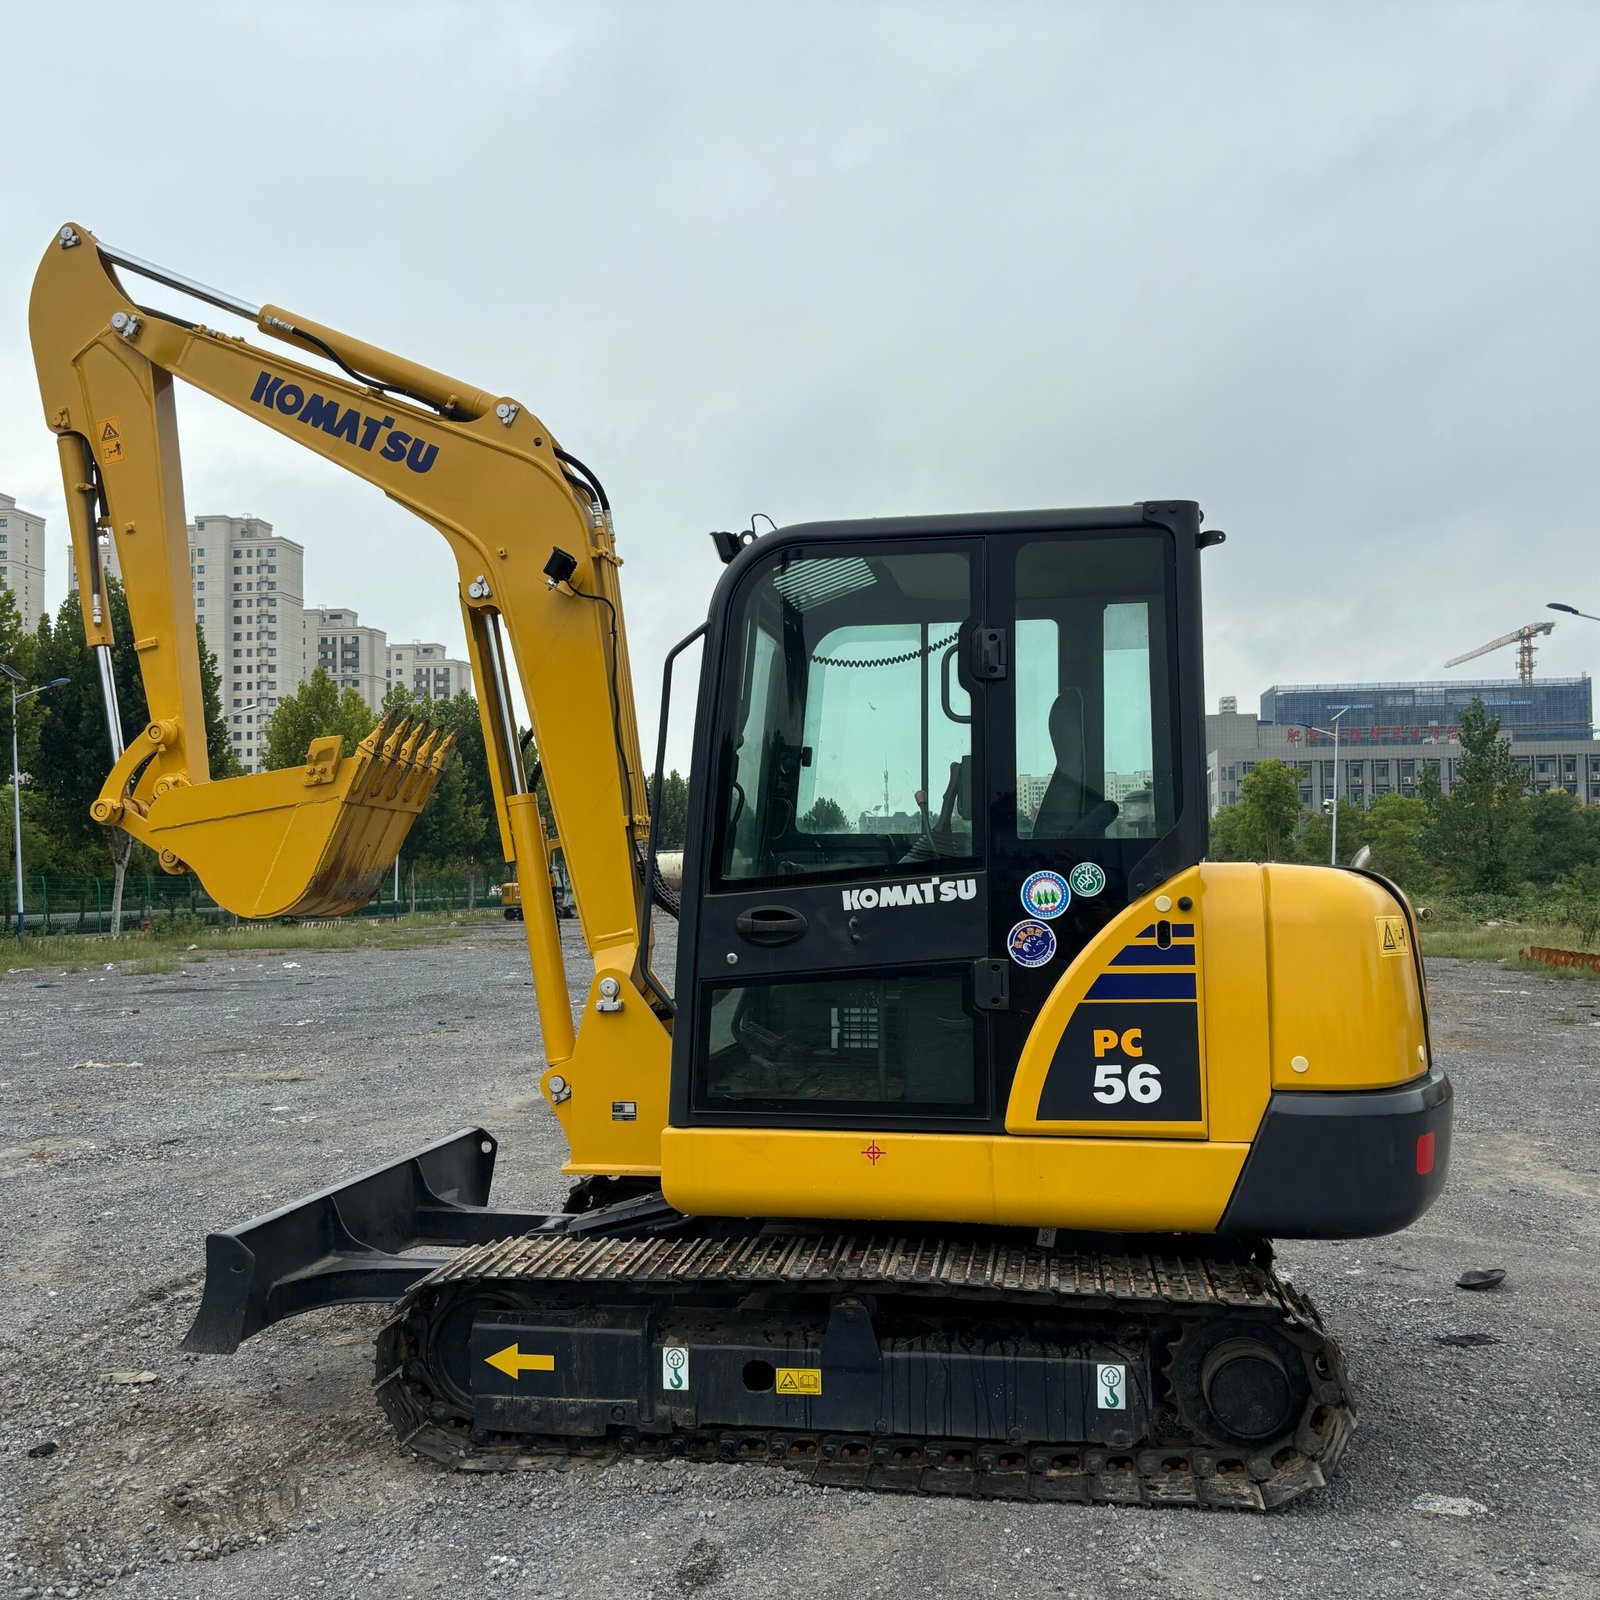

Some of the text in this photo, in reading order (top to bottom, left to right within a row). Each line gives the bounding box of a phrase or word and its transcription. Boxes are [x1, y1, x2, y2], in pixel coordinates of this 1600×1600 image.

[250, 370, 440, 474] KOMATSU
[842, 877, 977, 911] KOMATSU
[1093, 1028, 1143, 1057] PC
[1093, 1063, 1162, 1104] 56
